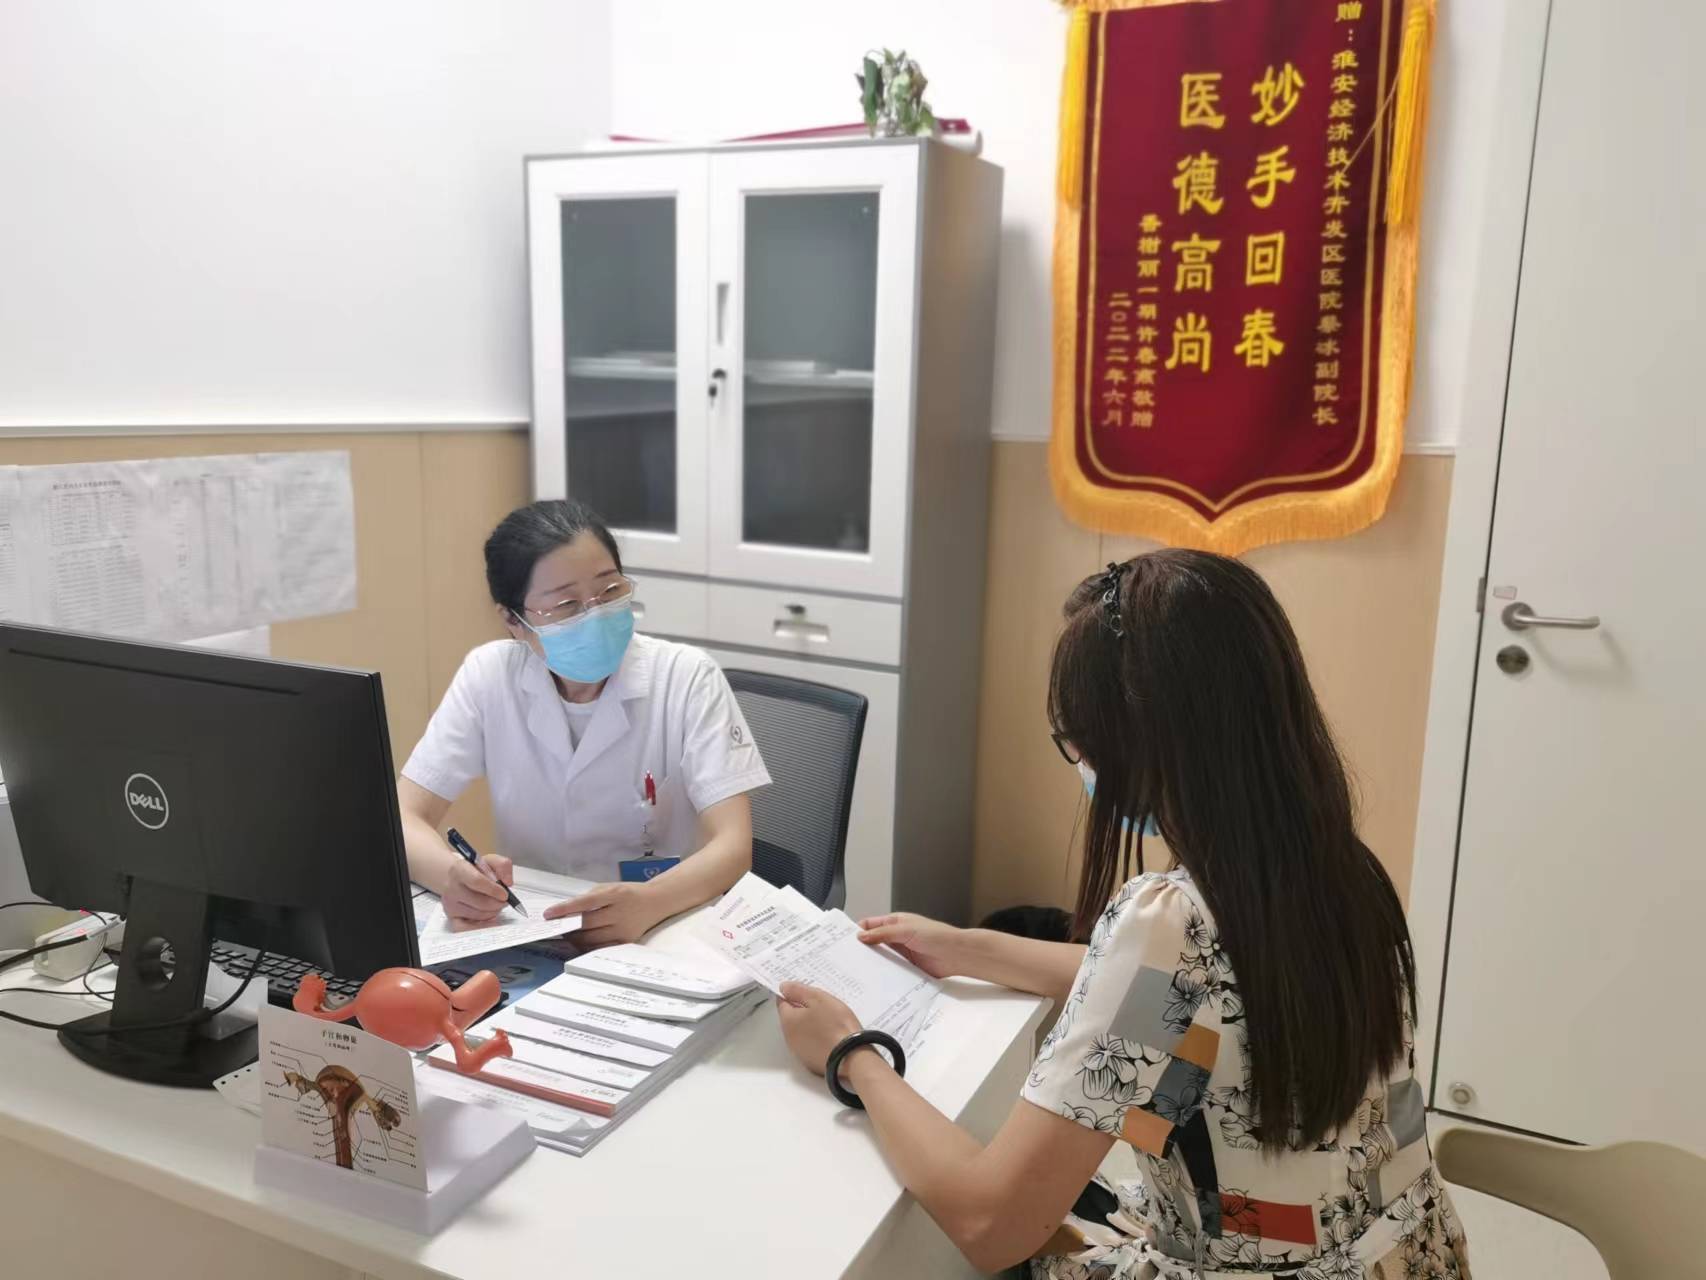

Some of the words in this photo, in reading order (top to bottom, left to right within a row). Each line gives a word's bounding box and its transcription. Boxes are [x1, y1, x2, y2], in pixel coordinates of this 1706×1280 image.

[1164, 73, 1226, 373] 医德高尚
[1234, 61, 1305, 368] 妙手回春
[129, 791, 165, 811] DELL
